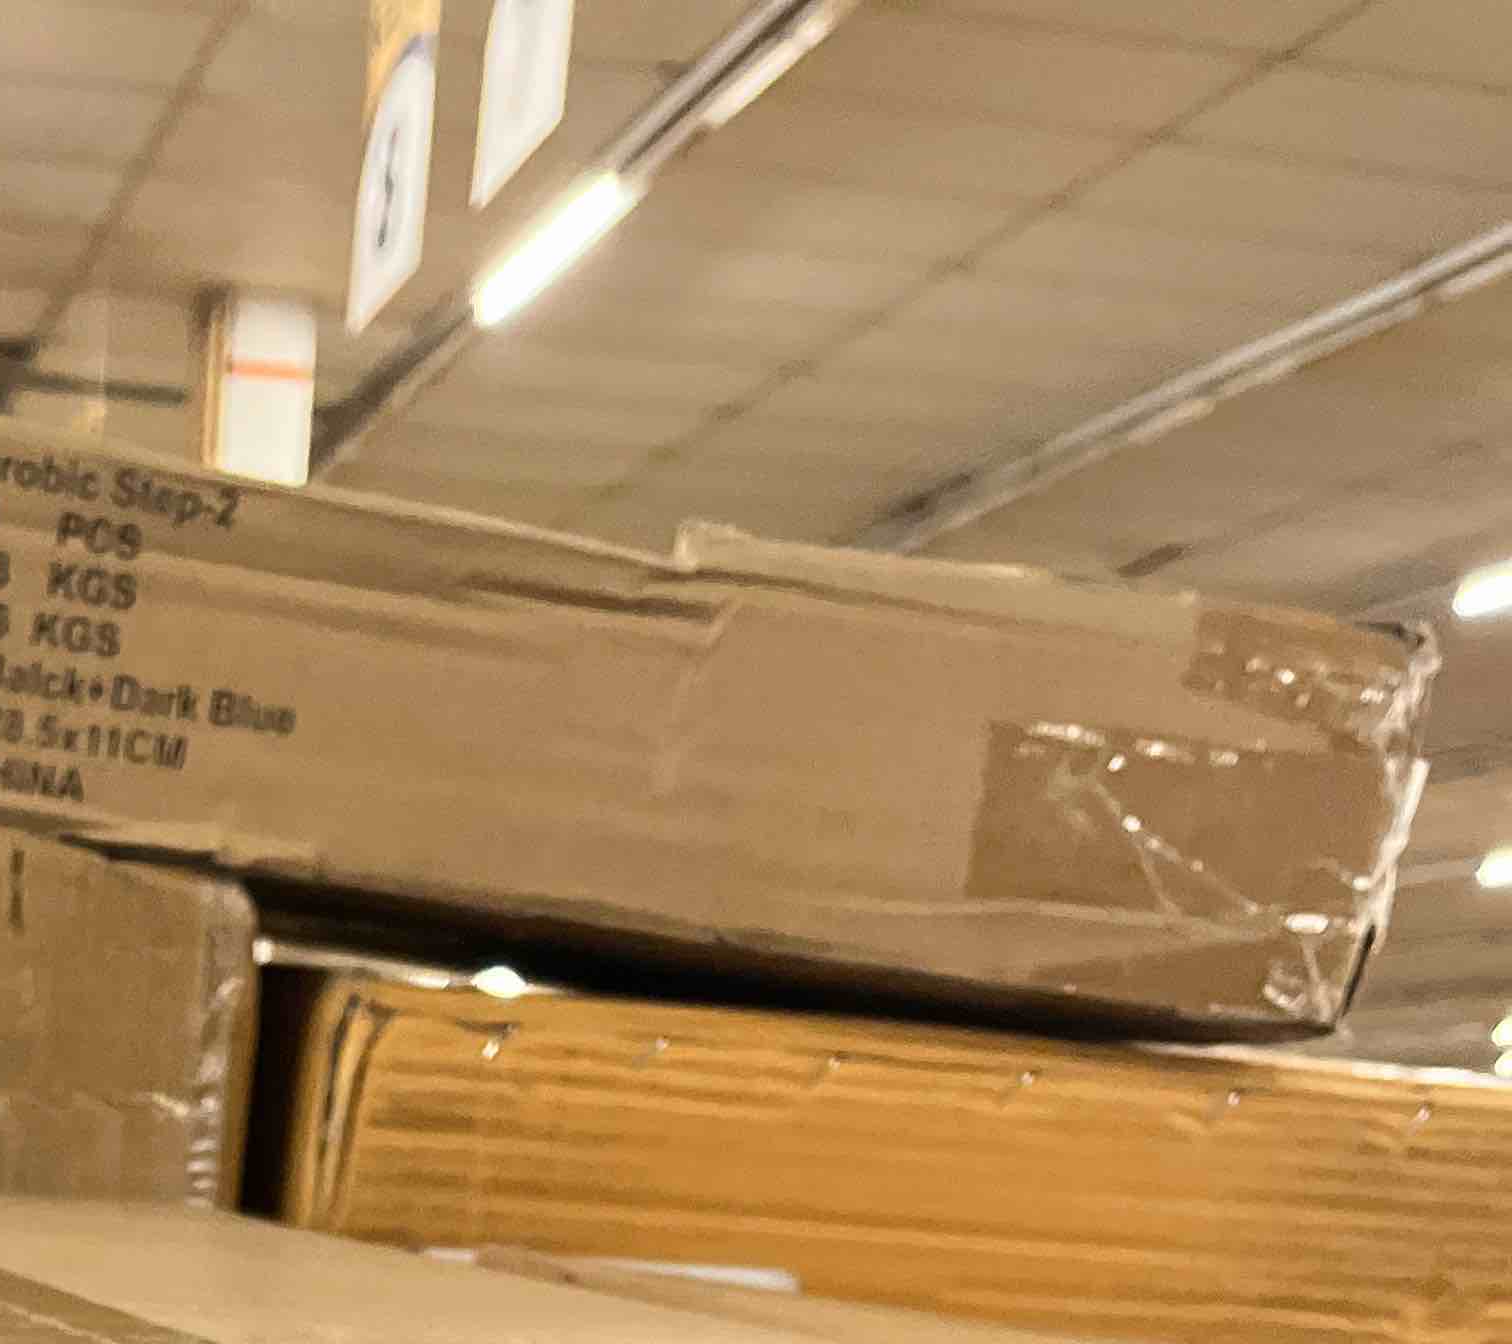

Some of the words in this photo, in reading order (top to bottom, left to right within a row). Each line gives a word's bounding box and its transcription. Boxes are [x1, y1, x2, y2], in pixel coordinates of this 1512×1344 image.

[55, 511, 141, 560] PCS
[47, 559, 137, 610] KGS
[29, 612, 120, 658] KGS
[208, 687, 296, 735] Blue
